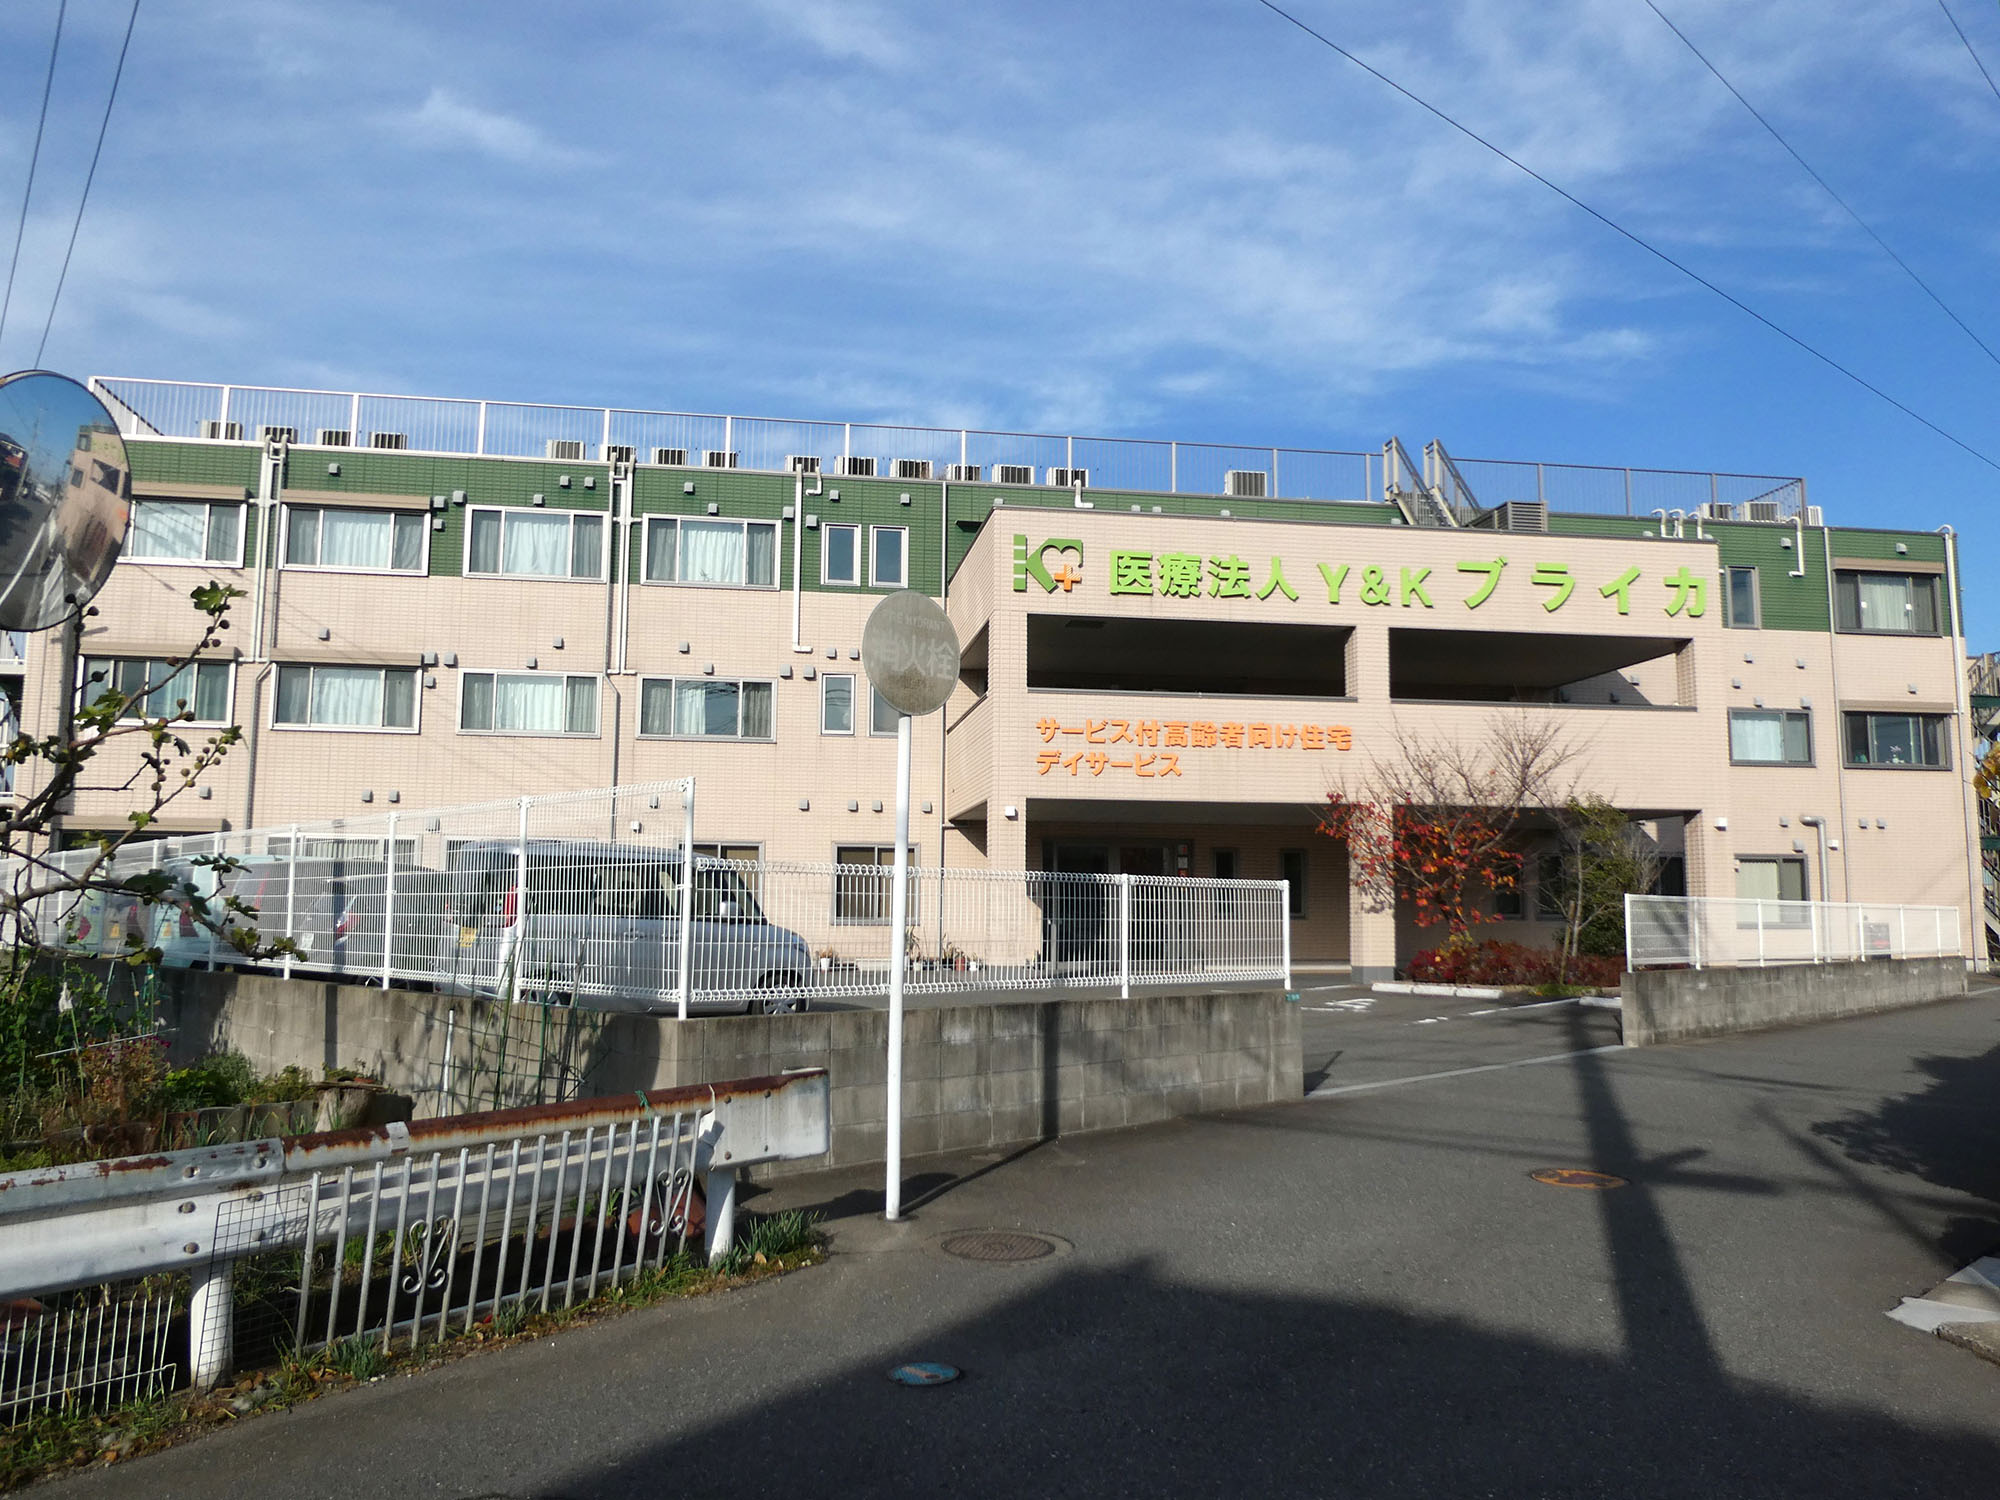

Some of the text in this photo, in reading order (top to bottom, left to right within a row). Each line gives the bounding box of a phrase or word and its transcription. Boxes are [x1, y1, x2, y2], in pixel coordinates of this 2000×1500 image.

[1456, 556, 1708, 617] ブライカ
[1036, 718, 1352, 750] サービス付高齢者向け住宅
[1036, 751, 1182, 777] デイサービス
